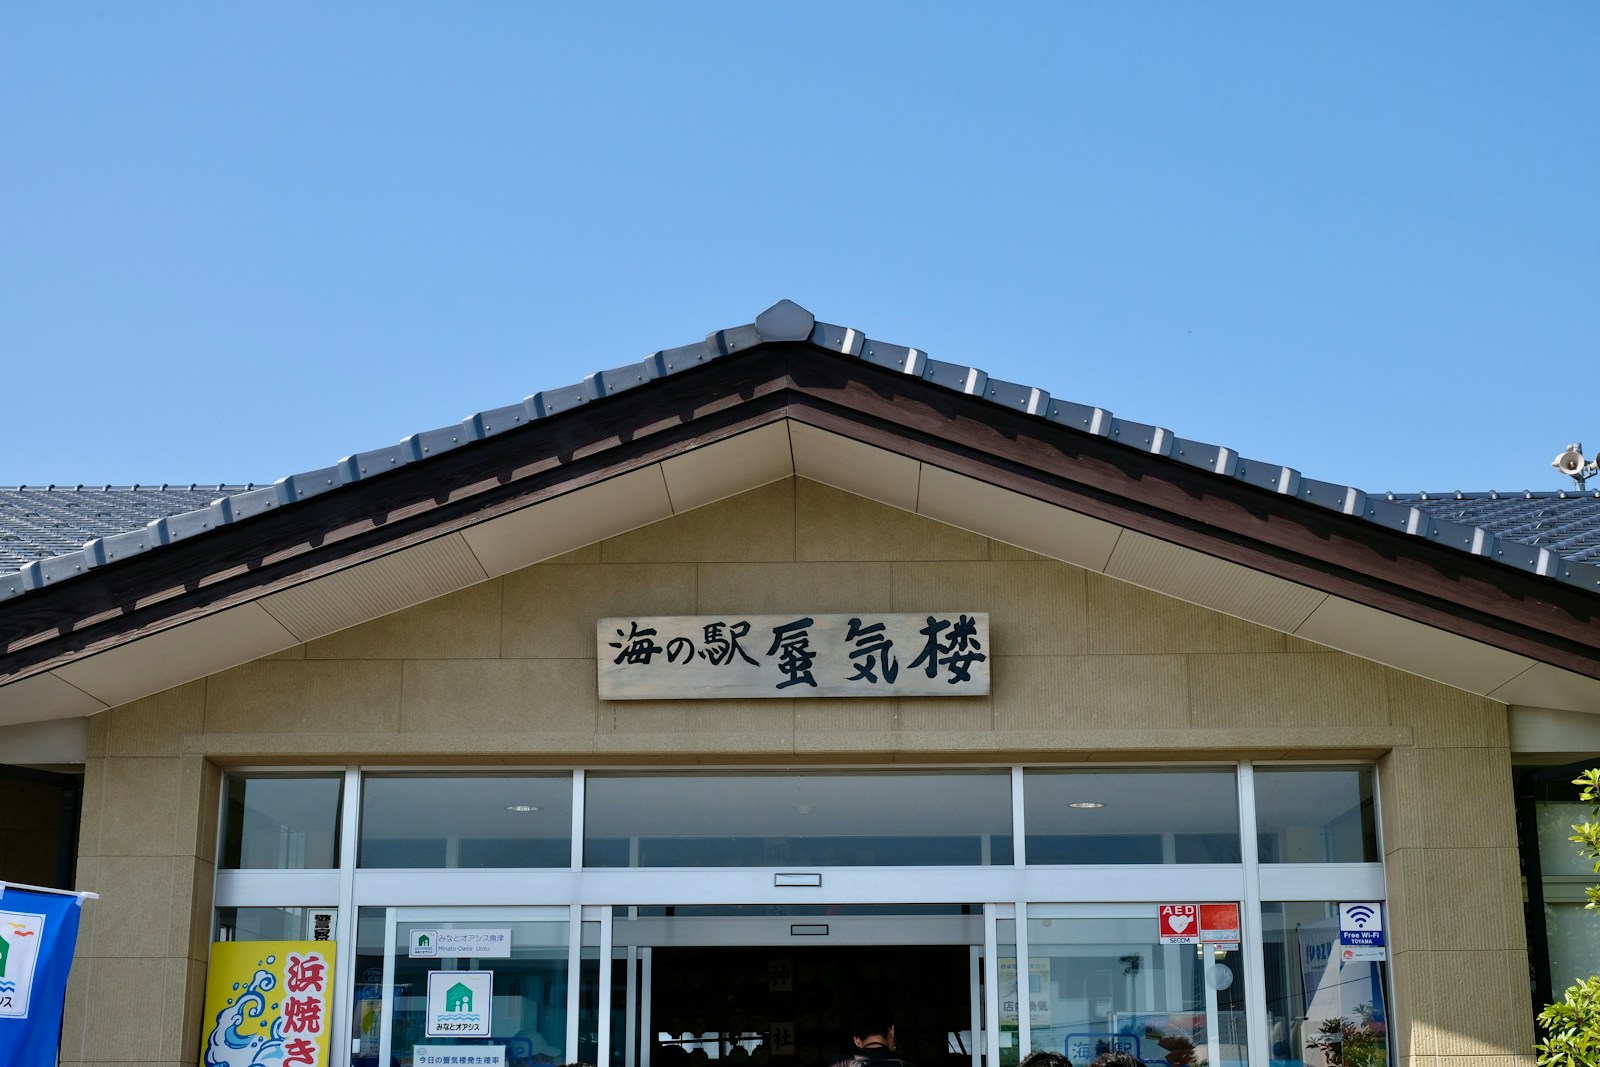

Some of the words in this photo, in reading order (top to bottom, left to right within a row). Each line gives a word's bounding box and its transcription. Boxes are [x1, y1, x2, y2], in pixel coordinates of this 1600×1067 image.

[1162, 905, 1195, 915] AED
[438, 934, 505, 942] みなとオアシス魚津
[1343, 931, 1360, 939] Free
[1361, 931, 1380, 939] Wi-Fi
[283, 955, 325, 1067] 浜焼き
[436, 1023, 480, 1031] みなとオアシス
[419, 1056, 500, 1064] 今日の蜃気楼発生確率
